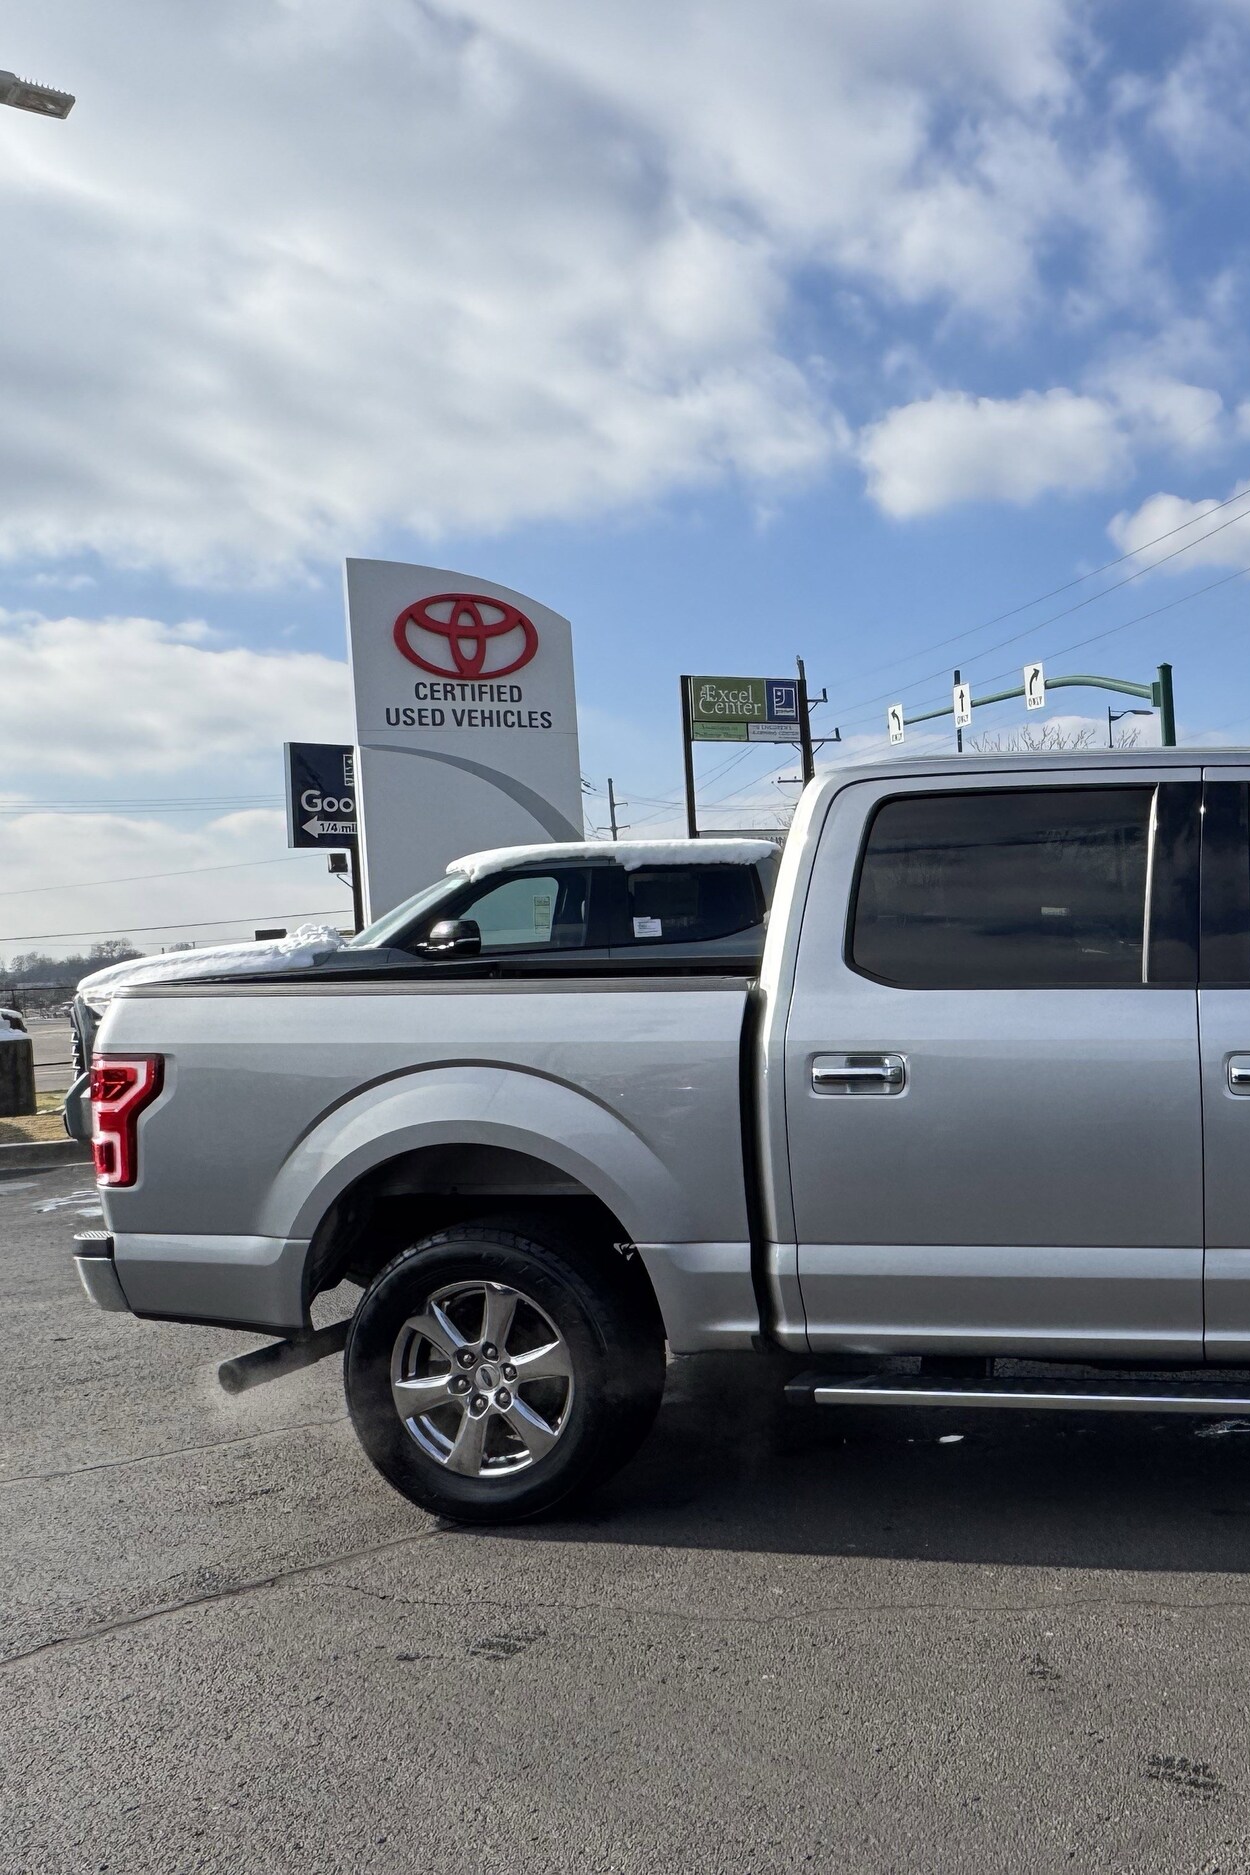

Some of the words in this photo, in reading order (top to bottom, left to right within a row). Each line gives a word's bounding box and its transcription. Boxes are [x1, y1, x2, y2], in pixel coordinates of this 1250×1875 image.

[414, 681, 523, 703] CERTIFIED
[705, 684, 754, 704] Excel
[699, 697, 762, 716] Center
[385, 707, 446, 727] USED
[451, 708, 553, 729] VEHICLES
[301, 789, 354, 813] Goo
[320, 823, 338, 832] 1/4
